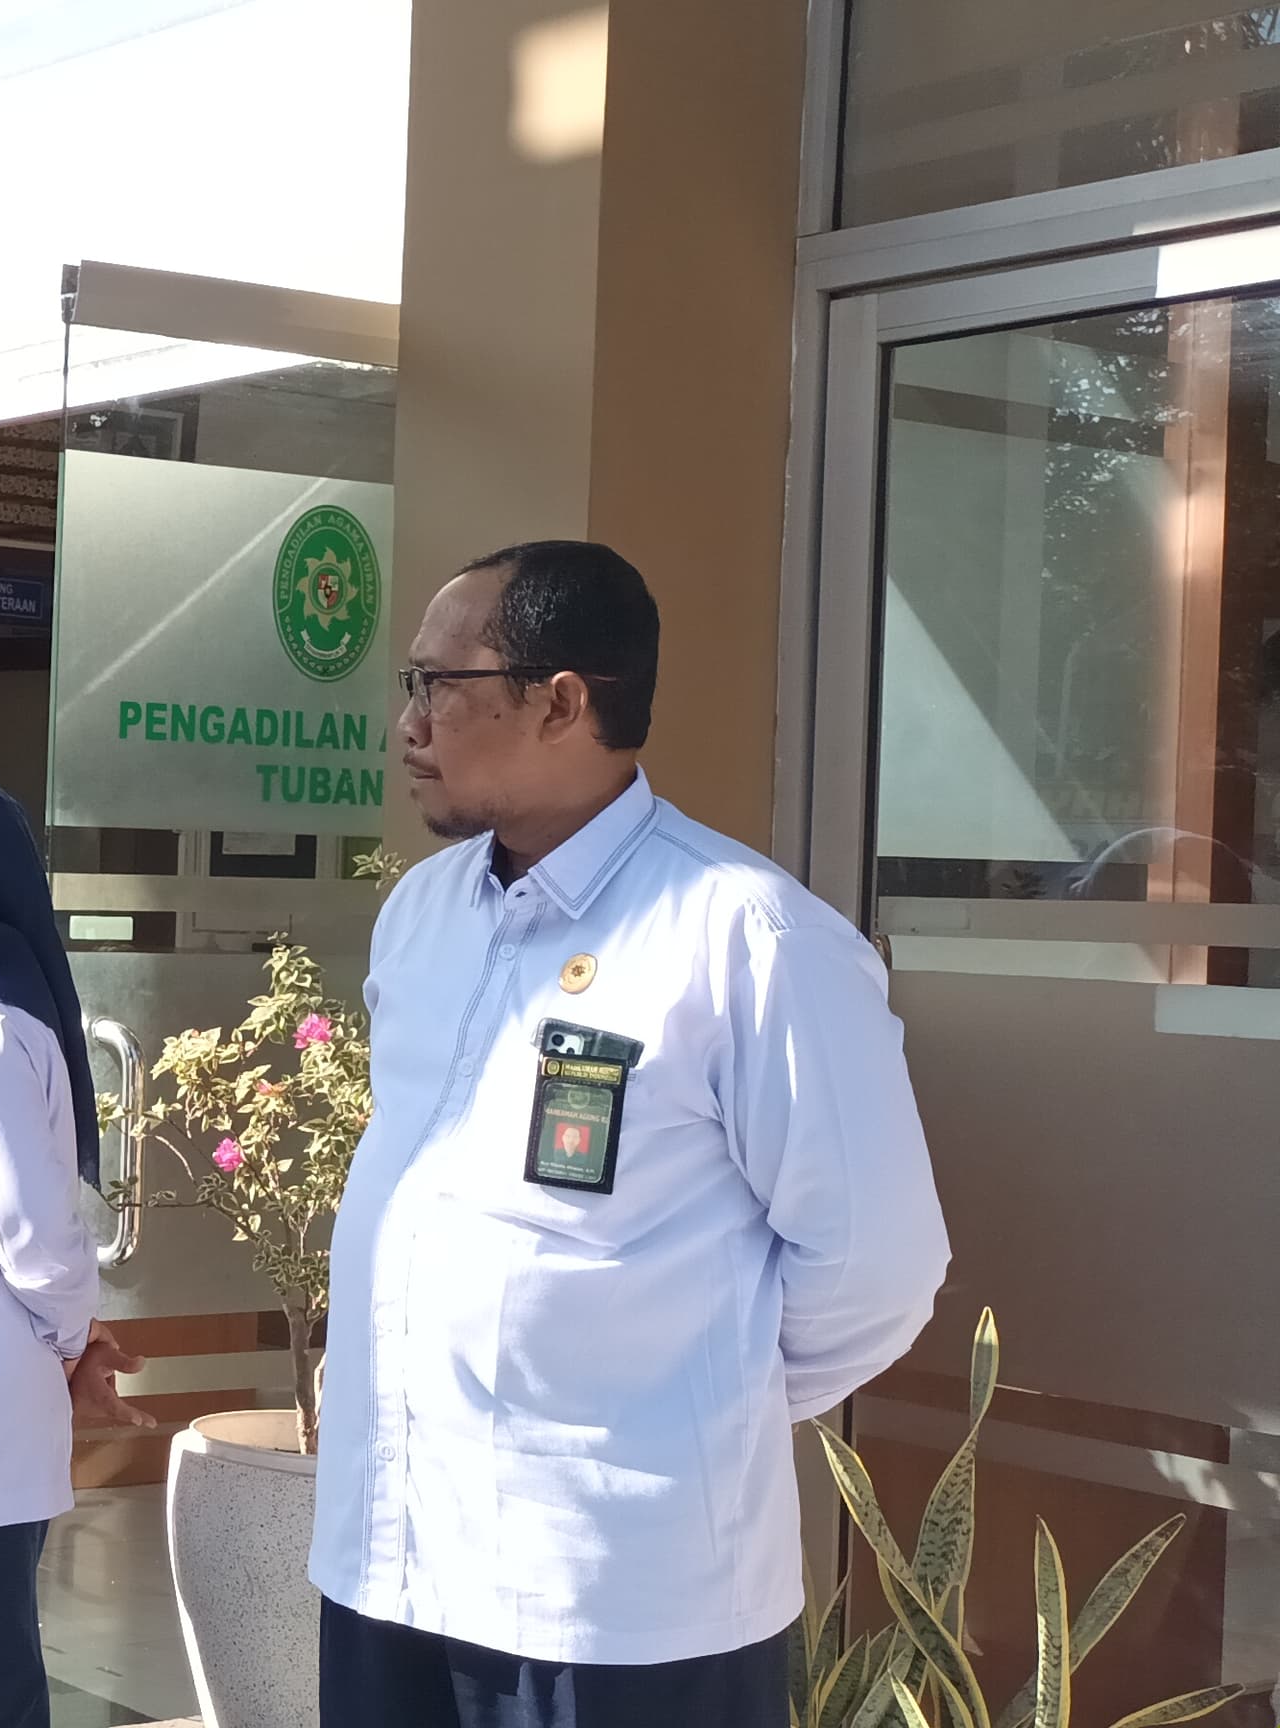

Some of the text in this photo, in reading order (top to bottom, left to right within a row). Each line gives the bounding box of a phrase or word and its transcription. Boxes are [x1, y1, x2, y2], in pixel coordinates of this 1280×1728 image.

[280, 514, 375, 605] PENGADILAN AGAMA TUBAN
[118, 701, 367, 751] PENGADILAN
[255, 764, 384, 807] TUBAN
